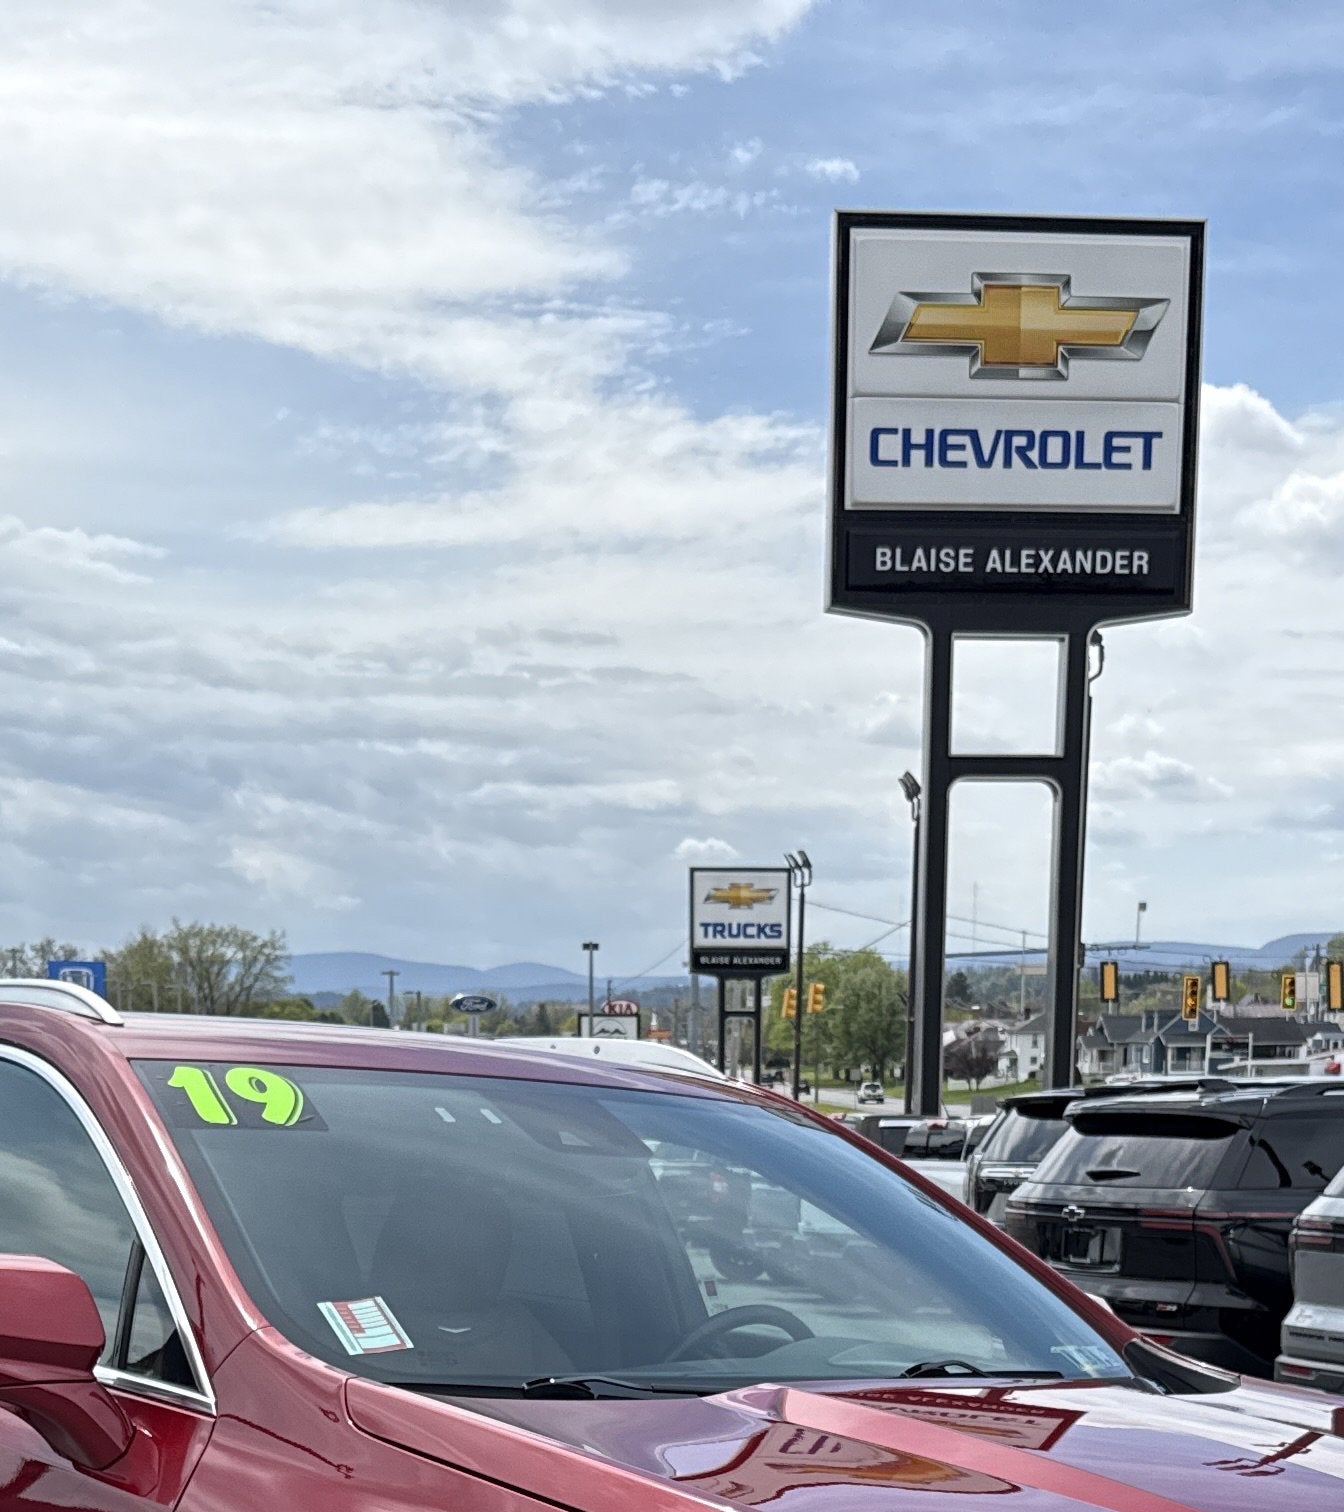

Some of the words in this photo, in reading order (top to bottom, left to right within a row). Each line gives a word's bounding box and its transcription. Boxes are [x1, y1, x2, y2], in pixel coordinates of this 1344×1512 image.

[870, 427, 1163, 470] CHEVROLET
[875, 547, 974, 573] BLAISE
[985, 548, 1150, 575] ALEXANDER
[699, 922, 783, 940] TRUCKS
[699, 956, 730, 965] BLAISE
[733, 956, 783, 965] ALEXANDER
[608, 1003, 635, 1015] KIA
[167, 1066, 304, 1127] 19
